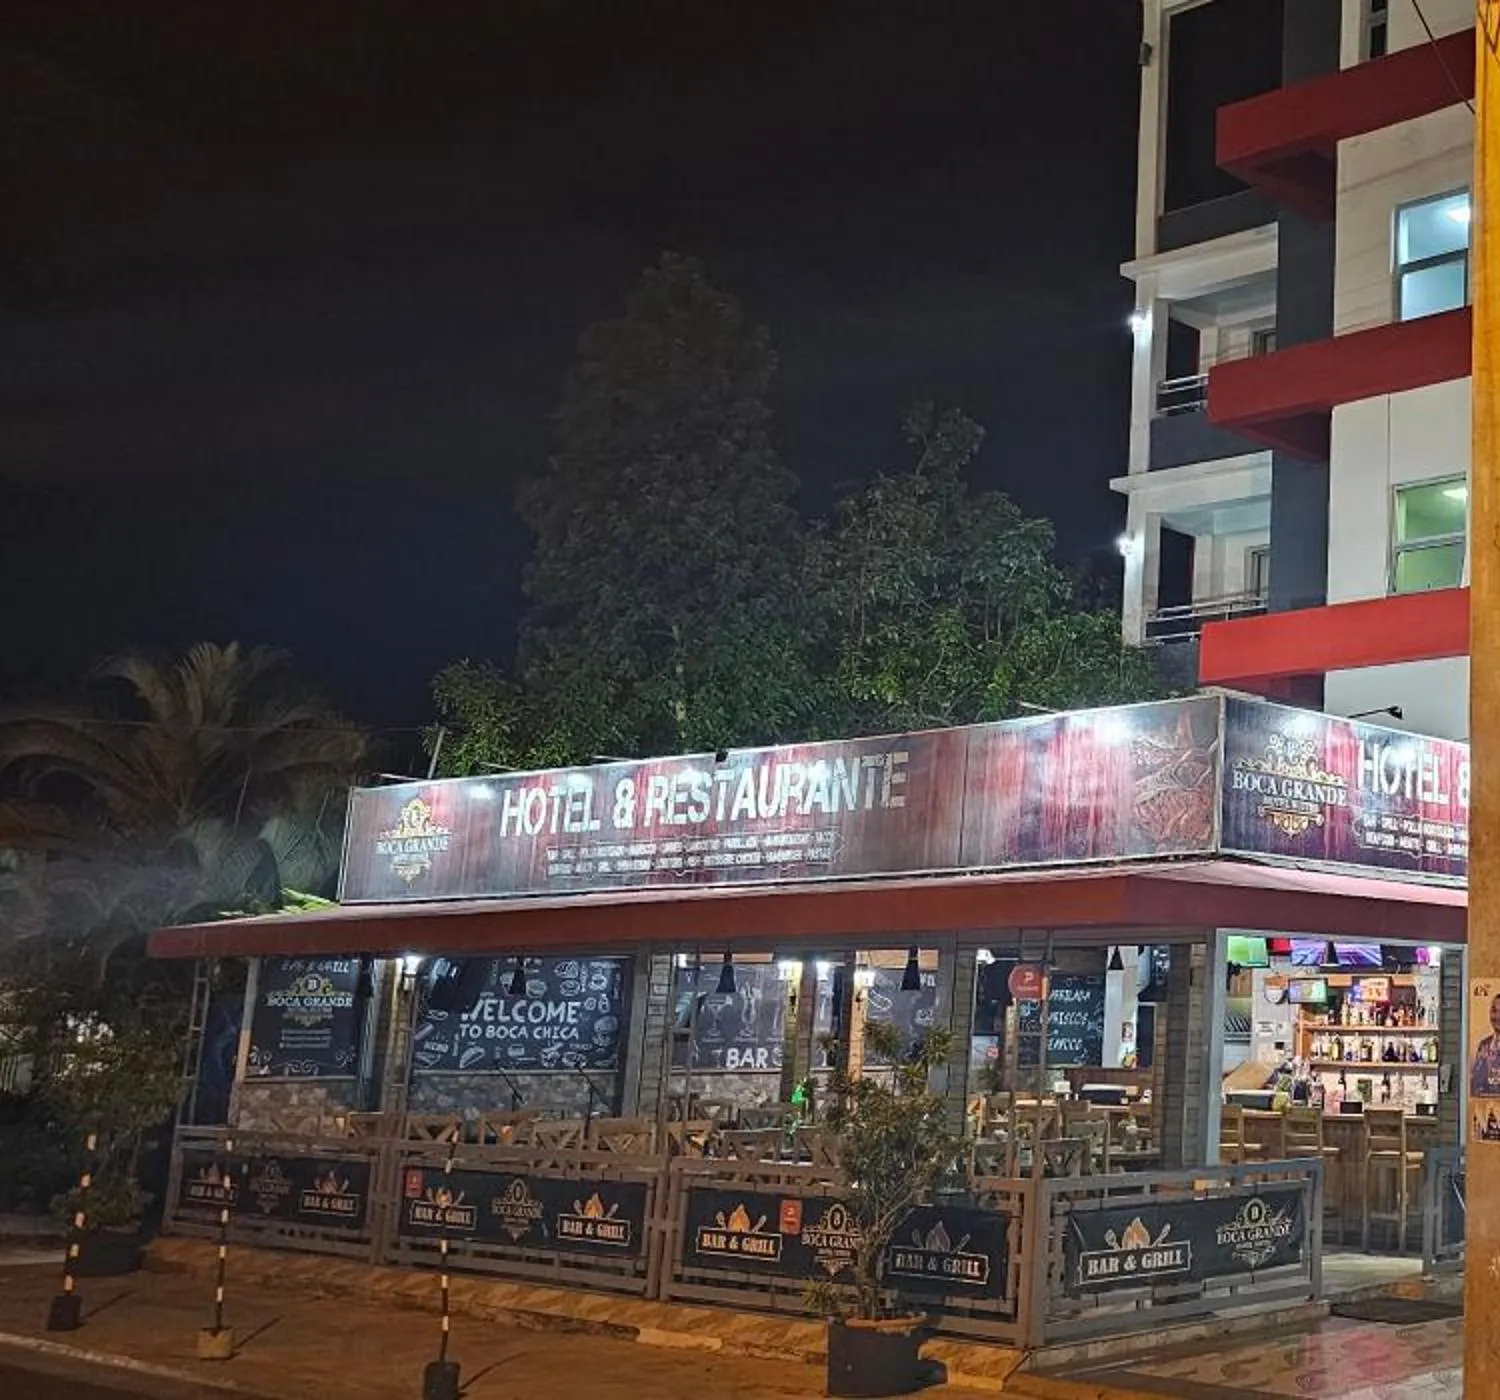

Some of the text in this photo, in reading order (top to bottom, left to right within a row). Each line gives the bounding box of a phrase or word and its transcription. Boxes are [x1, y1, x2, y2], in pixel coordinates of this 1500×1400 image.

[1358, 739, 1450, 805] HOTEL
[500, 751, 909, 837] HOTEL & RESTAURANTE
[1231, 769, 1278, 796] BOCA
[1281, 780, 1348, 806] GRANDE
[404, 835, 448, 853] GRANDE
[267, 997, 352, 1008] BOCA GRANDE
[459, 1024, 580, 1041] TO BOCA CHICA
[726, 1047, 769, 1069] BAR
[562, 1221, 625, 1240] BAR & GRILL
[829, 1233, 858, 1250] GRAN
[1216, 1230, 1246, 1245] BOCA
[702, 1233, 775, 1255] BAR & GRILL
[895, 1253, 981, 1277] BAR & GRILL
[1087, 1249, 1184, 1275] BAR & GRILL
